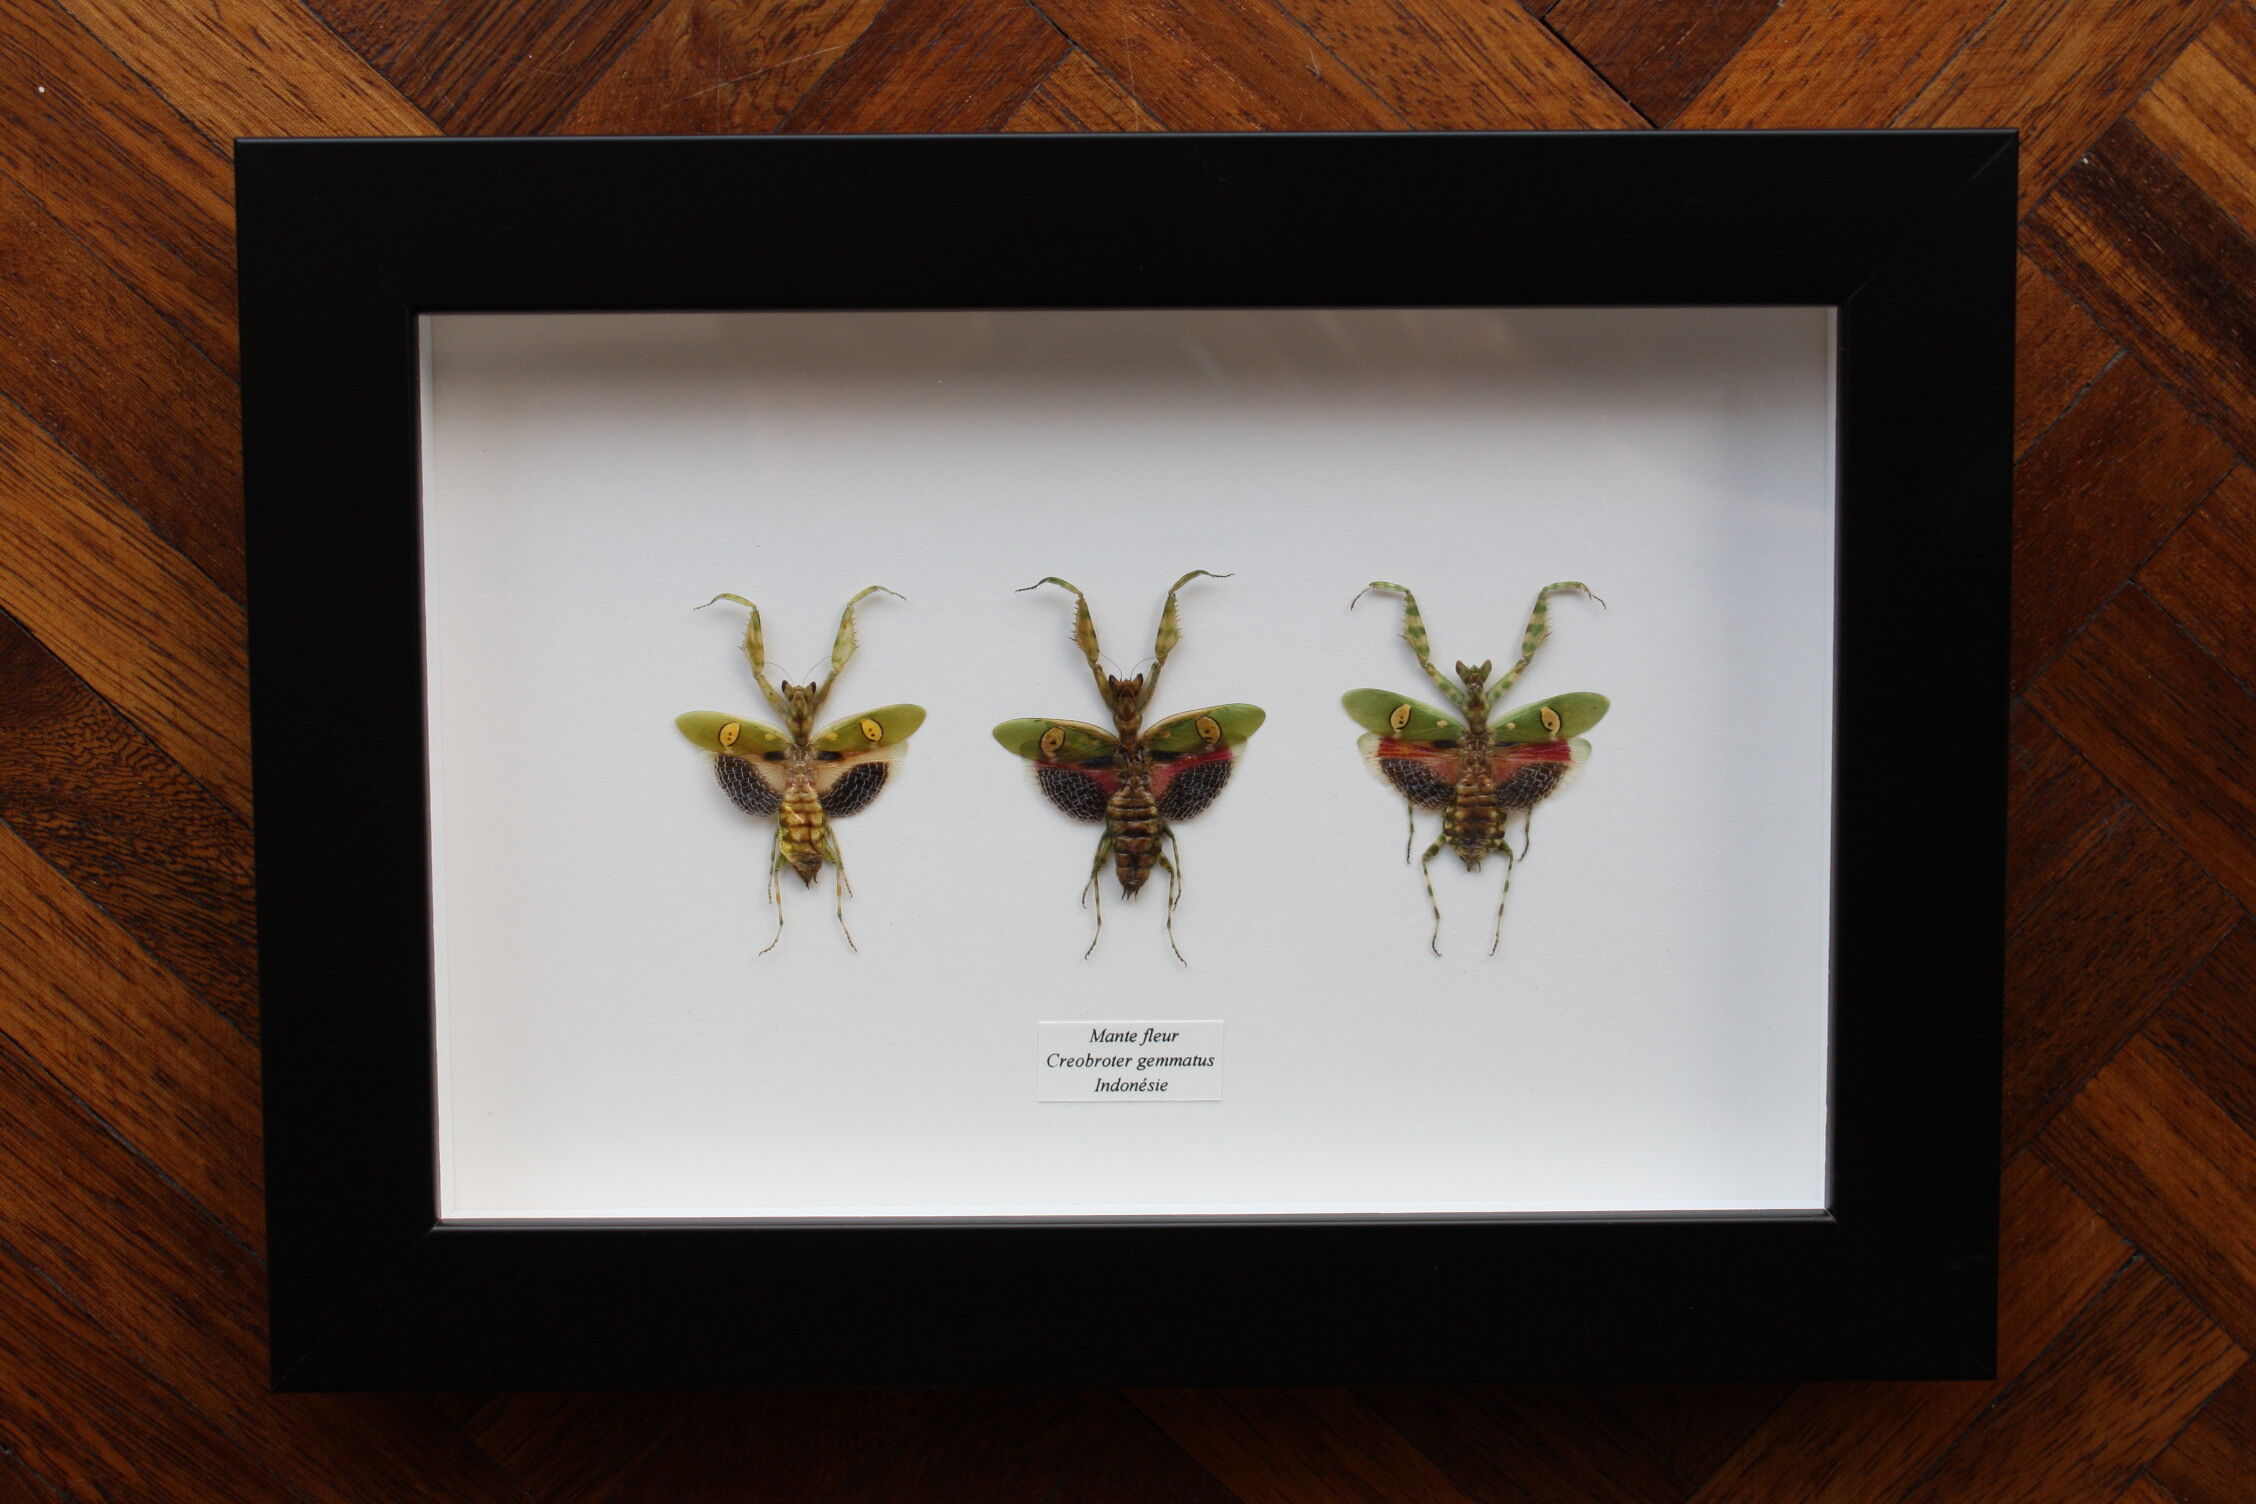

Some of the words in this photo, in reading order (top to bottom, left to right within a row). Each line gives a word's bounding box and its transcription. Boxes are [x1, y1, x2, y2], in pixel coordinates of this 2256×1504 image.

[1089, 1028, 1138, 1044] Mante
[1139, 1027, 1180, 1047] fleur
[1046, 1053, 1133, 1069] Creobroter
[1136, 1054, 1215, 1070] gemmatus
[1093, 1077, 1169, 1092] Indonésie
